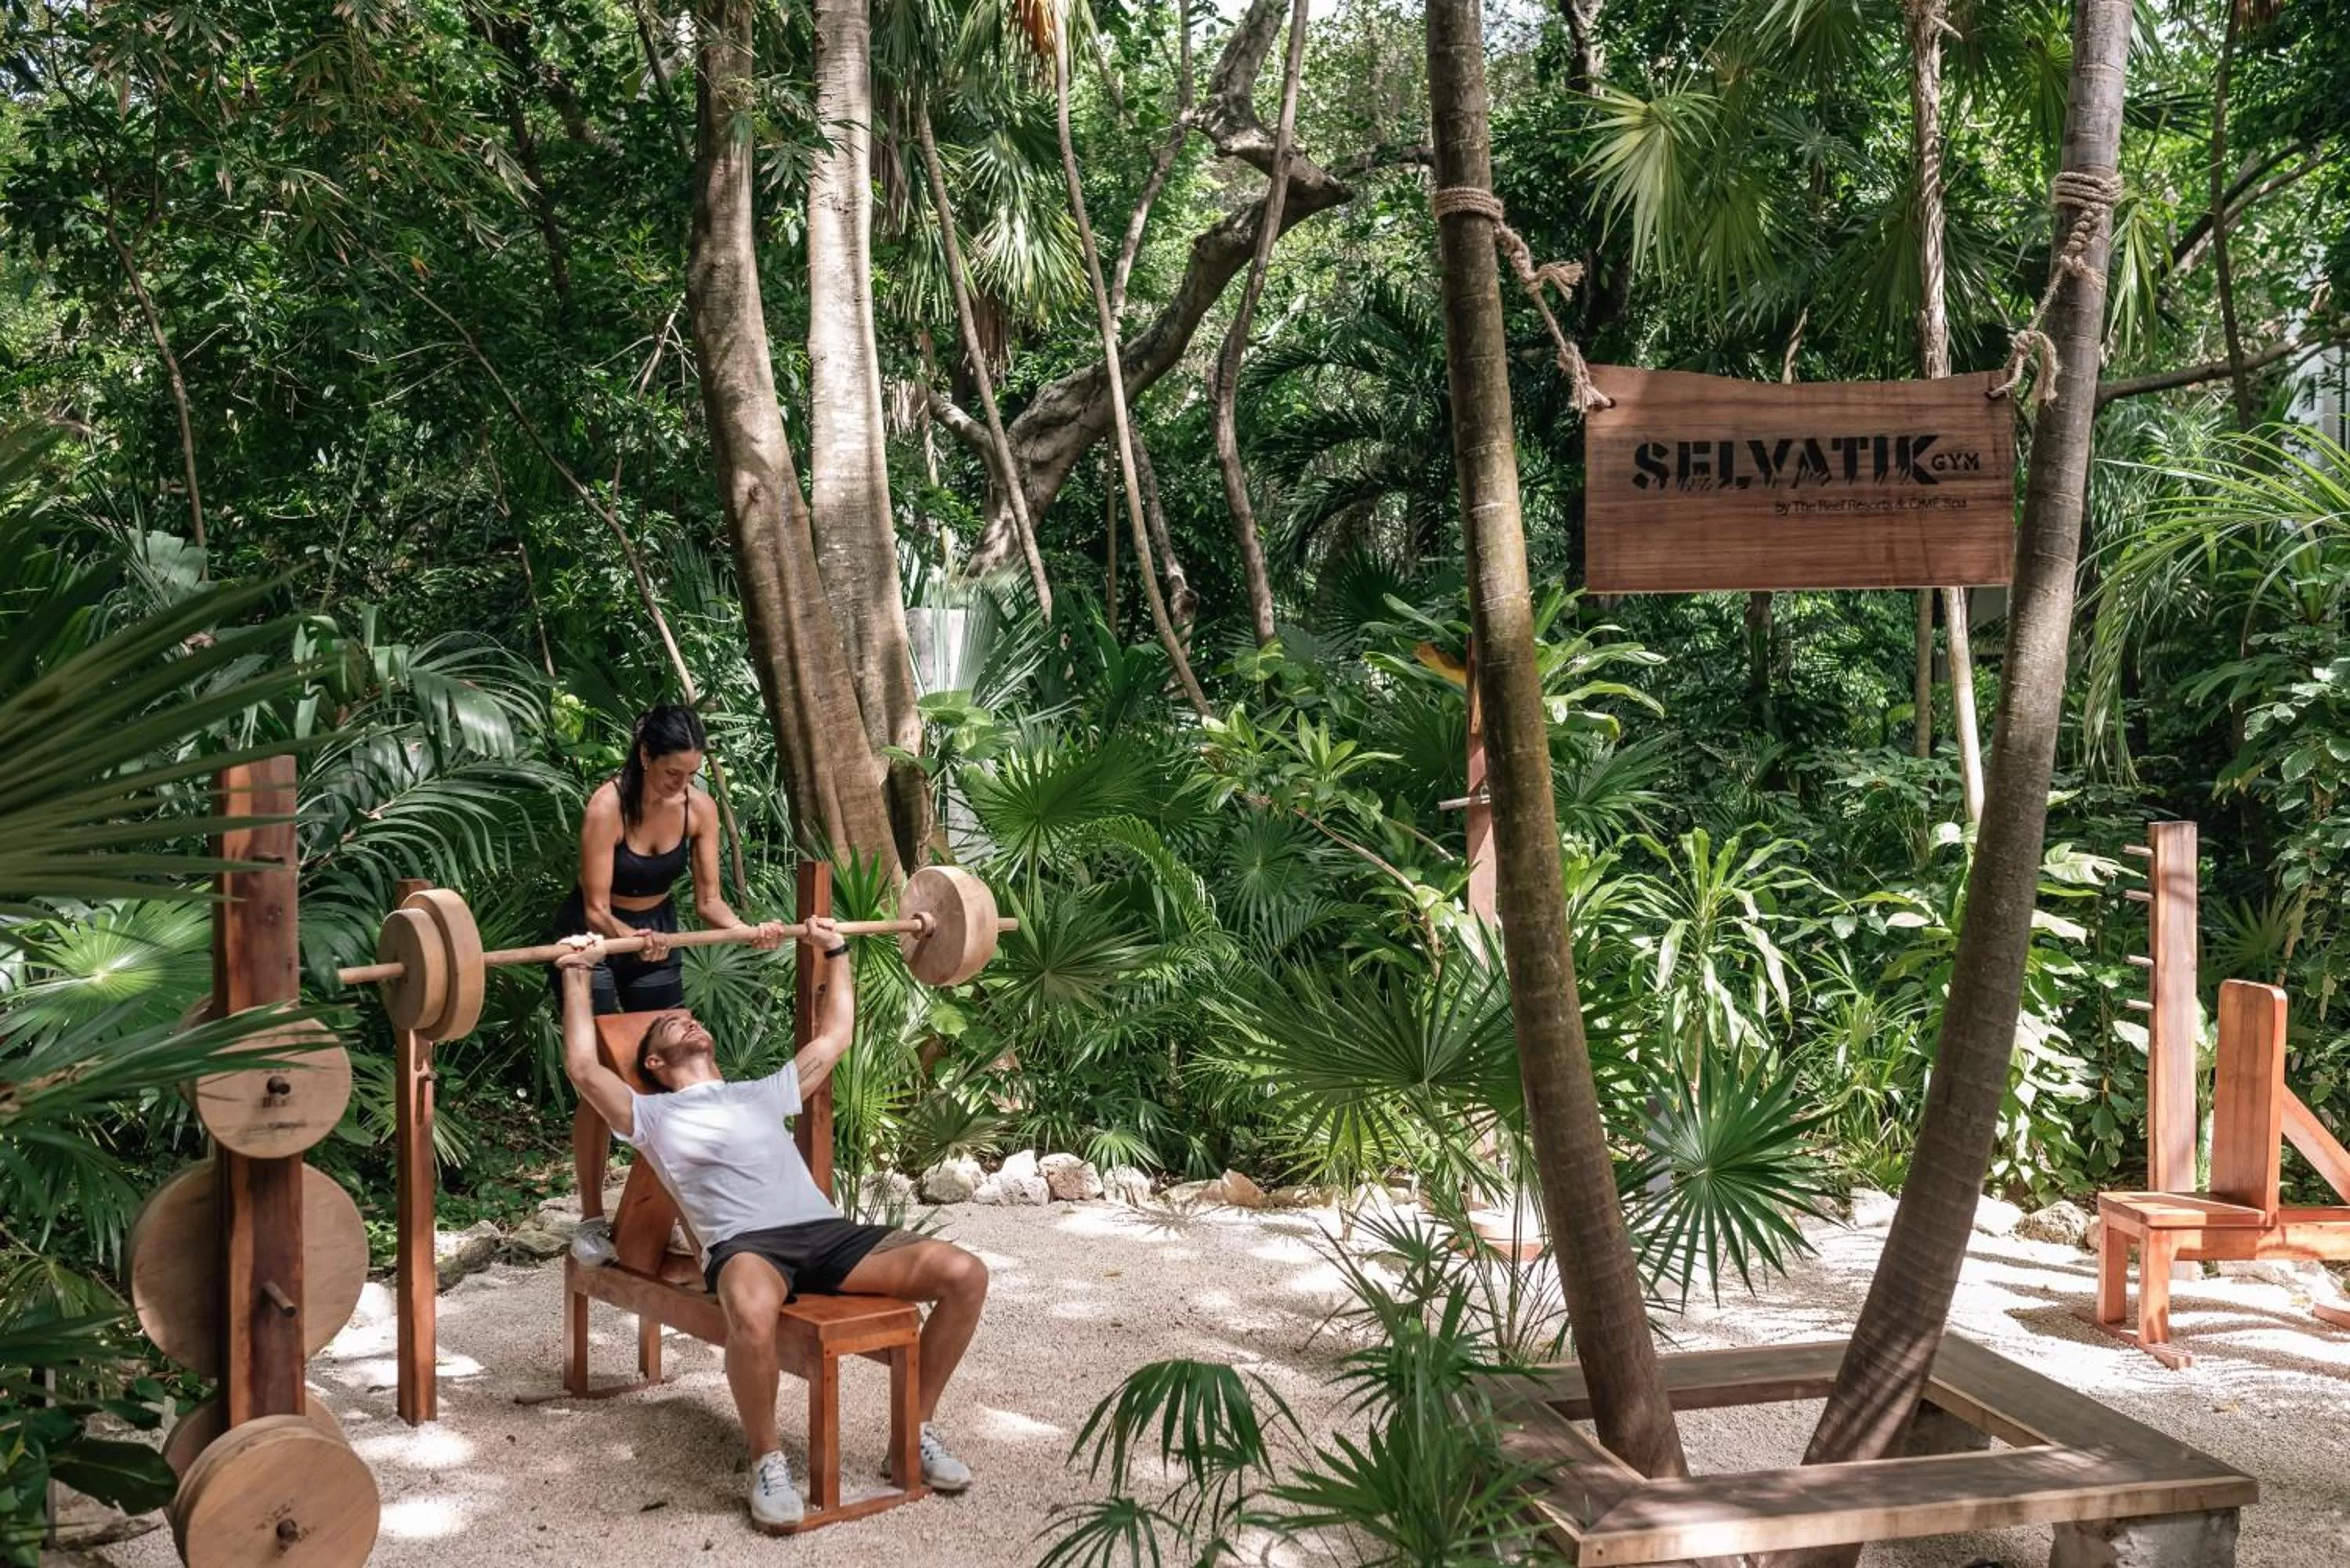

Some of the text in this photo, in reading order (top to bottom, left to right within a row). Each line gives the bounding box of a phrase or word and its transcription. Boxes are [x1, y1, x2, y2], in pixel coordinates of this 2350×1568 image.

[1632, 435, 1980, 491] SELVATIK GYM
[1775, 500, 1791, 515] by
[1791, 500, 1816, 512] The
[1817, 499, 1847, 511] Reef
[1849, 499, 1893, 512] Resorts
[1896, 498, 1907, 510] &
